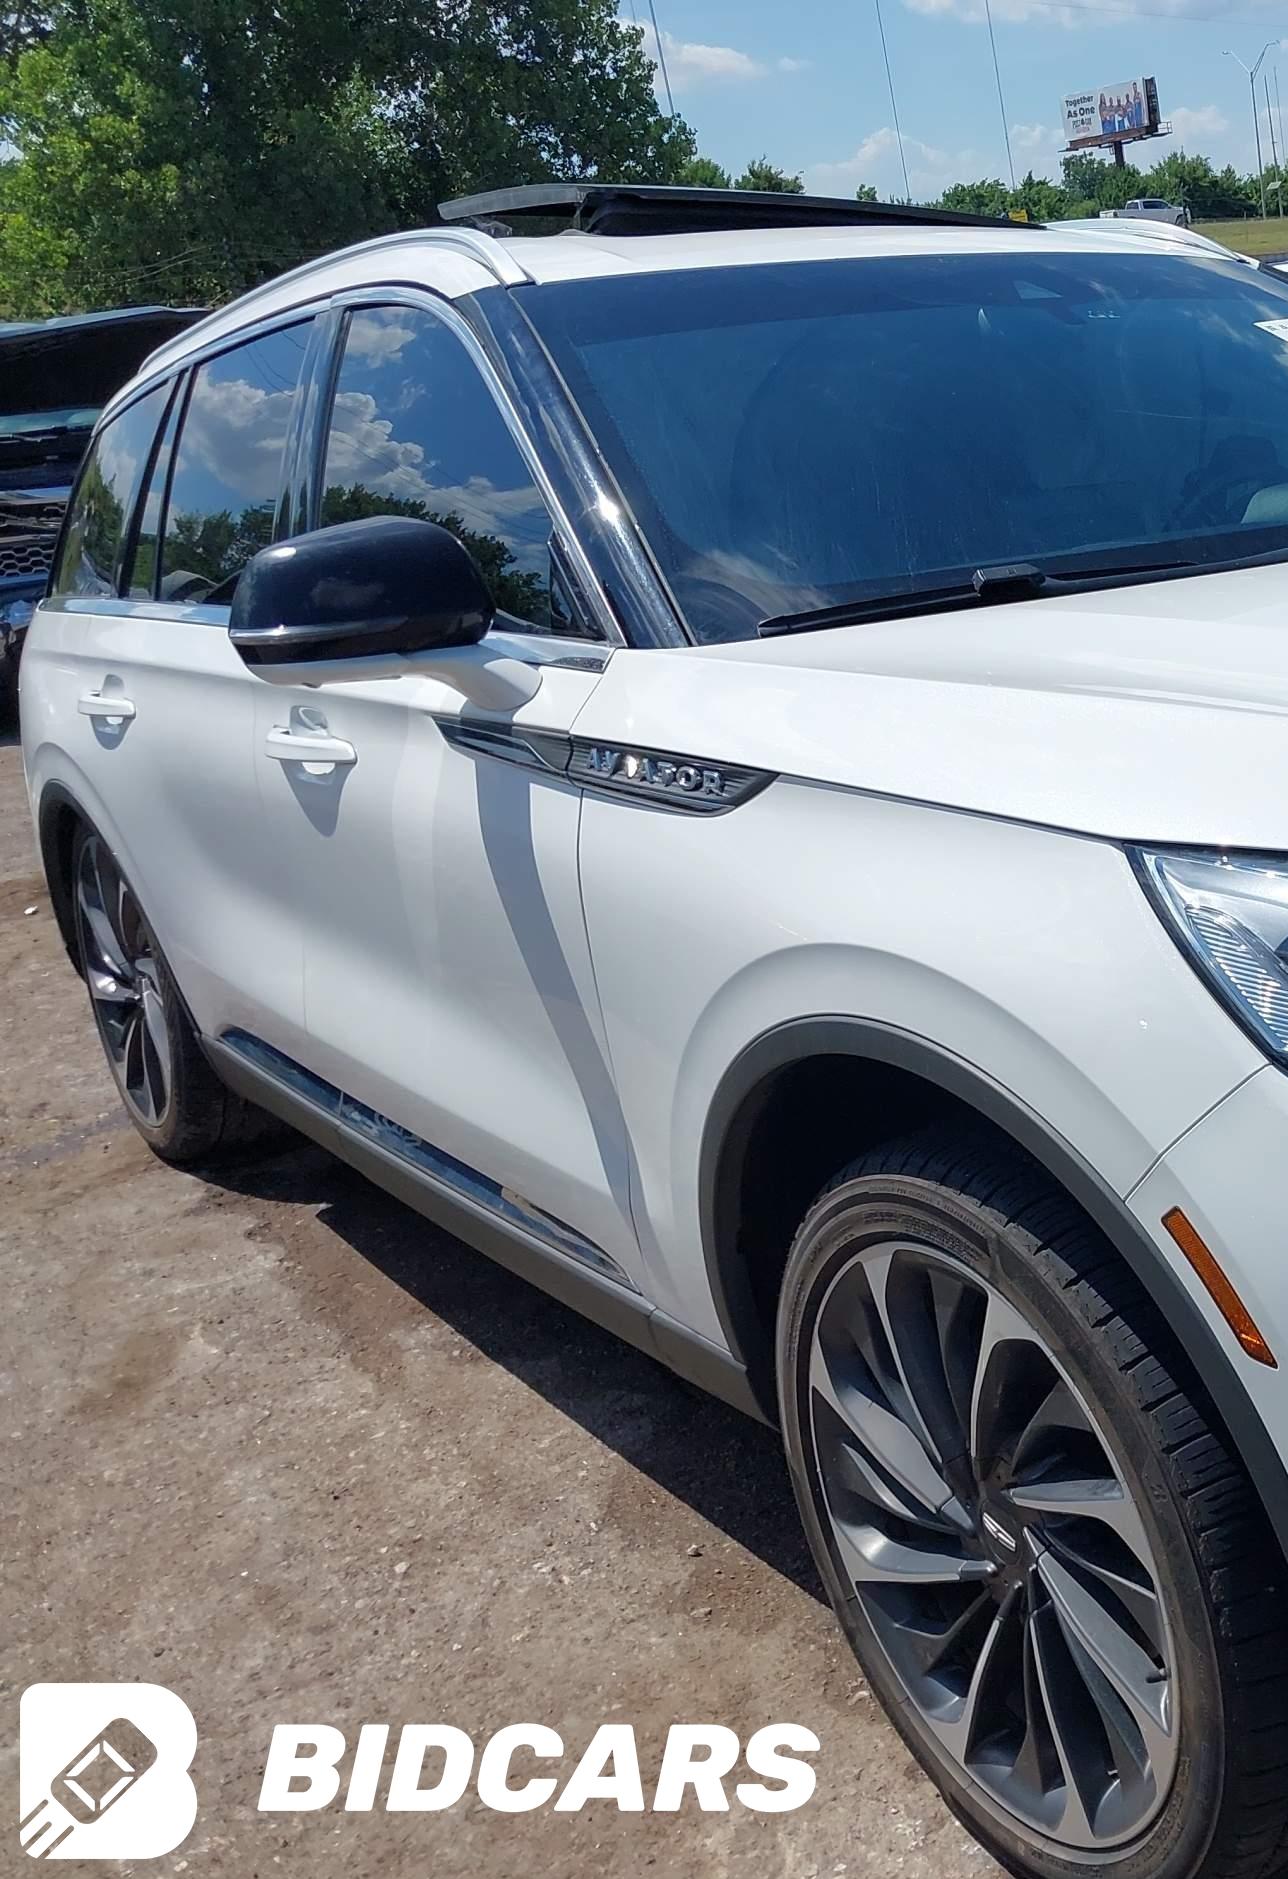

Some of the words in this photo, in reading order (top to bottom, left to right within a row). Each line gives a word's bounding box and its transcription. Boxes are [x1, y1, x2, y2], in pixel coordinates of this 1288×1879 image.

[1065, 95, 1094, 107] Together
[1067, 109, 1078, 119] As
[1079, 106, 1096, 116] One
